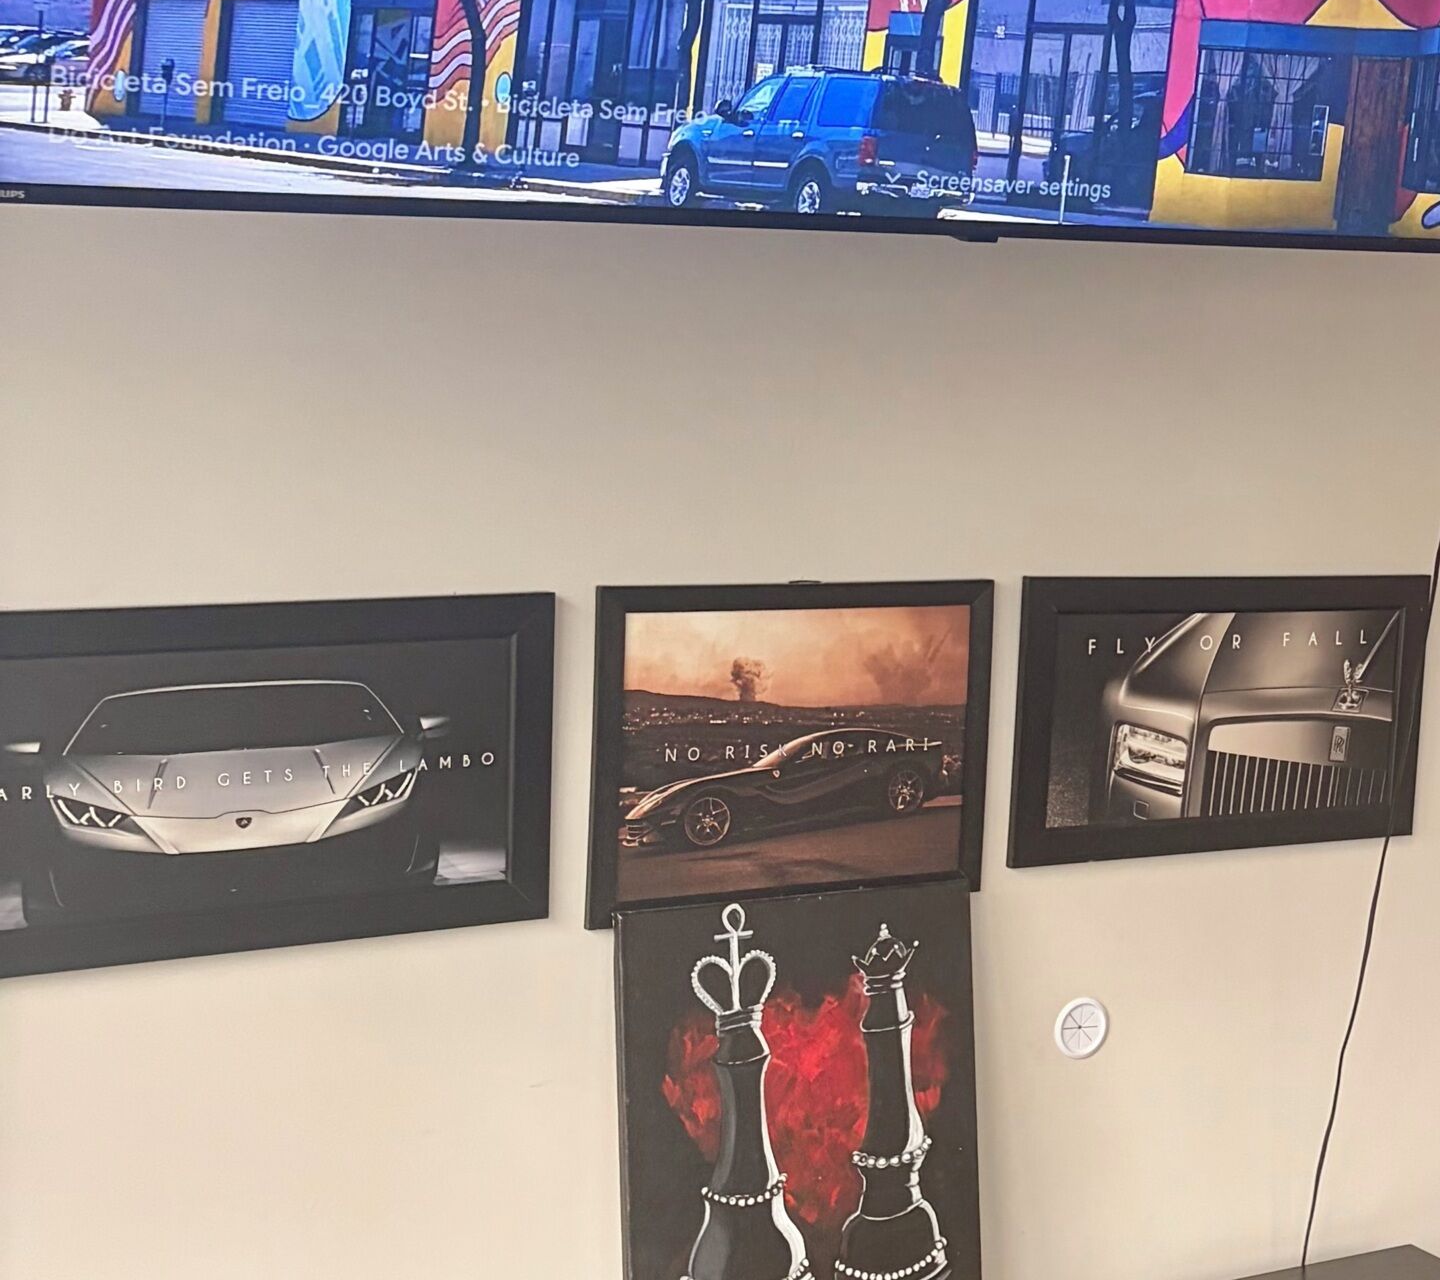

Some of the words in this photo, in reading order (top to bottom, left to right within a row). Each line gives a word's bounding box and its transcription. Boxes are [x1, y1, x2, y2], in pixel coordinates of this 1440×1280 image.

[50, 64, 168, 94] Bicicleta
[175, 72, 234, 98] Sem
[376, 85, 437, 114] Boyd
[443, 89, 473, 112] St.
[496, 94, 595, 120] Bicicleta
[599, 99, 648, 120] Sem
[317, 134, 409, 163] Google
[414, 140, 466, 163] Arts
[472, 142, 488, 163] &
[494, 144, 580, 168] Culture
[916, 170, 1033, 196] Screensaver
[1039, 177, 1111, 203] settings
[1087, 636, 1156, 656] FLY
[1199, 633, 1242, 651] OR
[1282, 628, 1368, 648] FALL
[665, 746, 701, 762] NO
[725, 743, 789, 760] RISK
[811, 740, 845, 756] NO
[867, 736, 929, 754] RARI
[0, 782, 81, 802] ARLY
[113, 774, 187, 794] BIRD
[217, 767, 294, 787] GETS
[321, 761, 372, 778] THE
[399, 750, 496, 772] LAMBO
